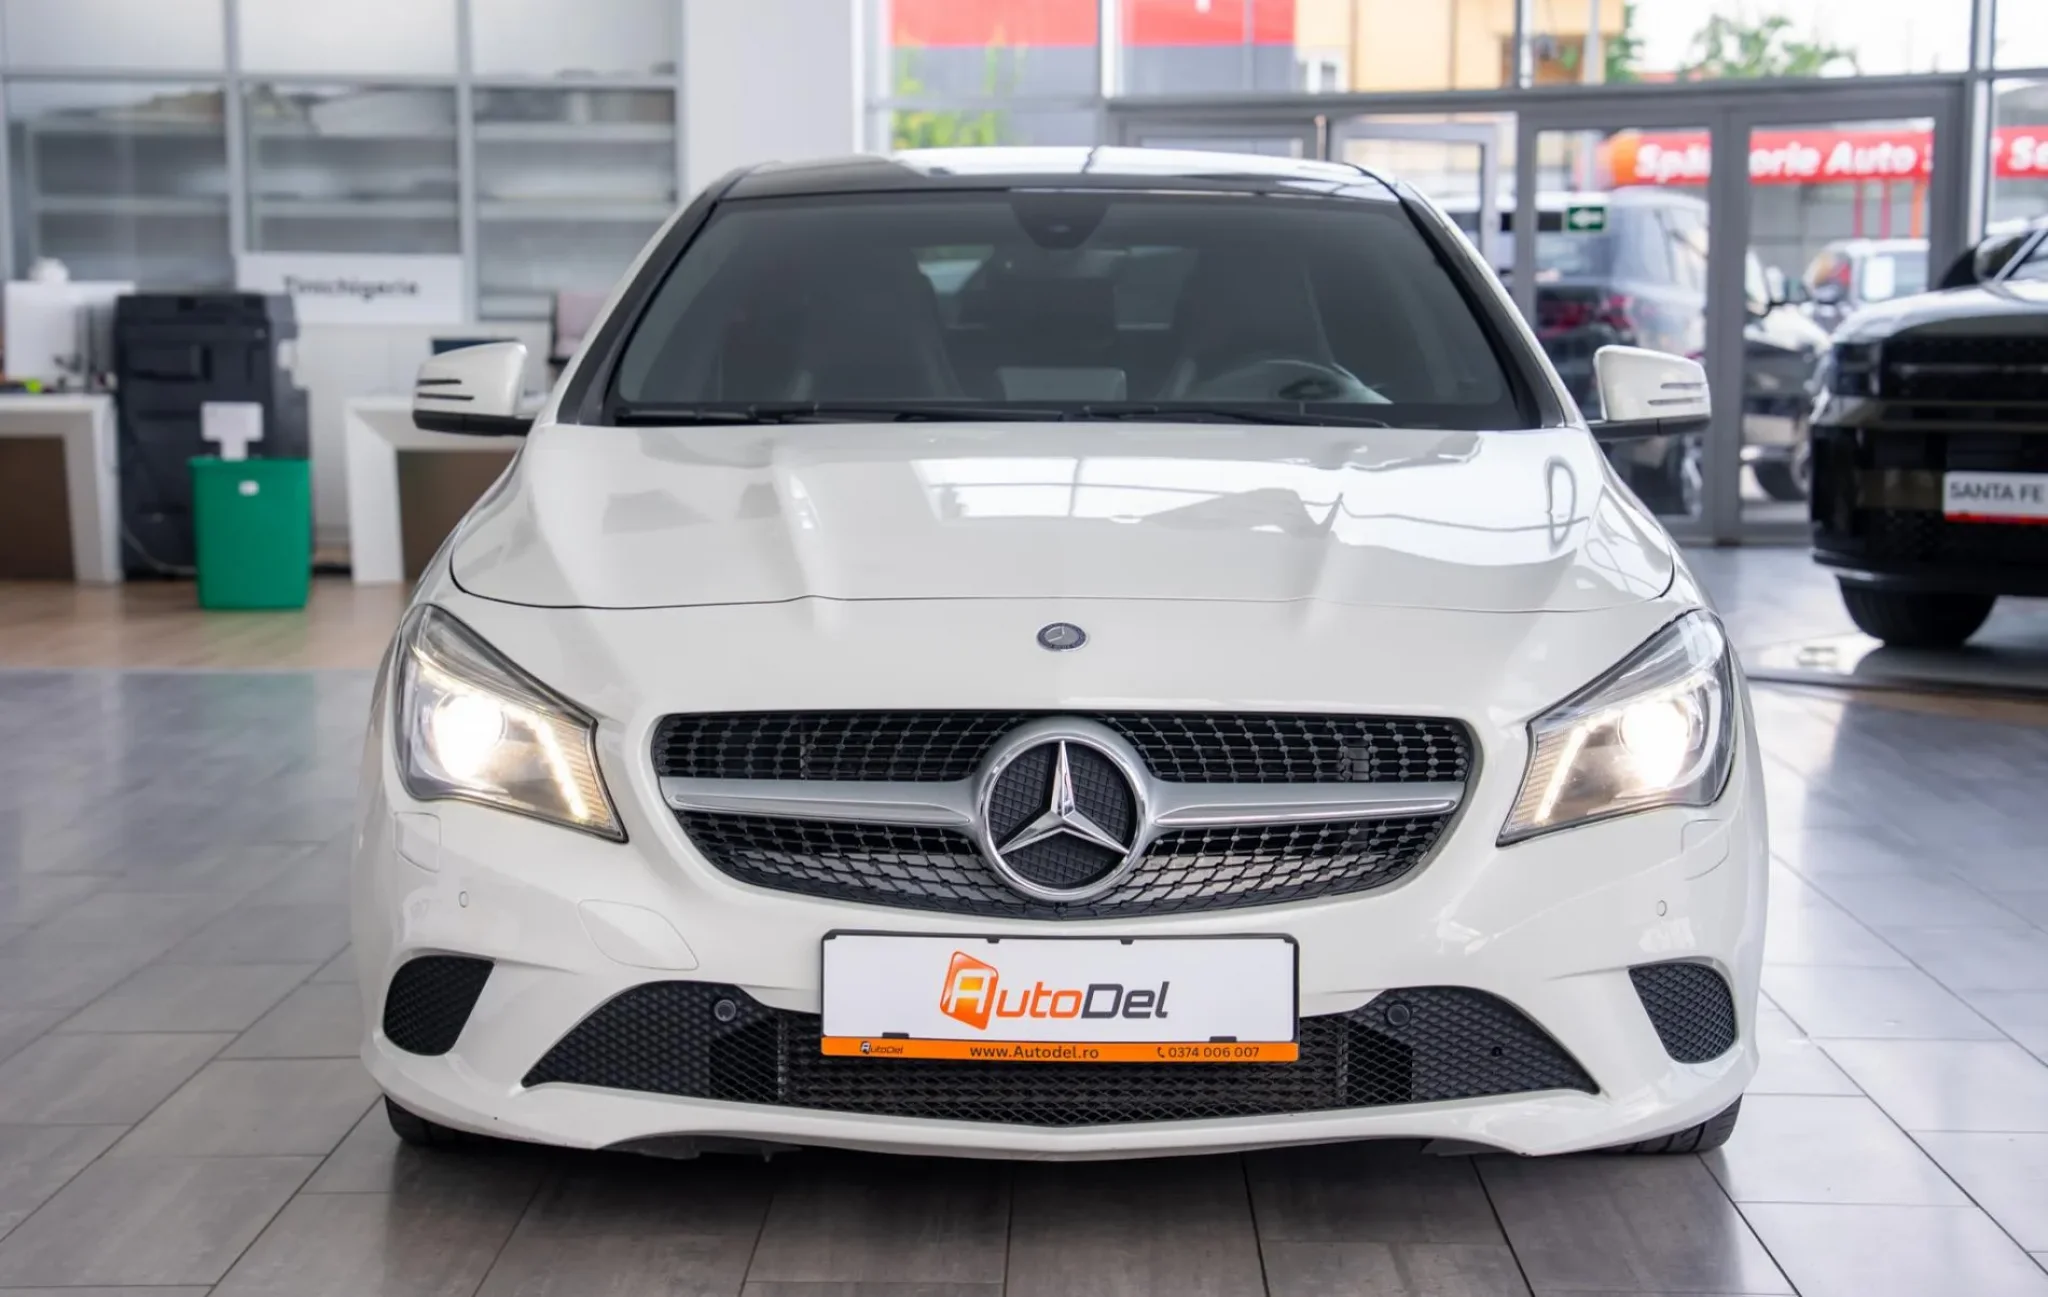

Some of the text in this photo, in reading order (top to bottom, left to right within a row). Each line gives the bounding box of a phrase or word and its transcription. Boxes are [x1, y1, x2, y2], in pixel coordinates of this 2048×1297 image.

[1824, 139, 1918, 175] Auto
[1950, 482, 2045, 504] SANTA FE
[945, 967, 1170, 1019] AutoDel
[969, 1045, 1100, 1059] www.Autodel.ro
[1168, 1046, 1260, 1058] 0374 006 007
